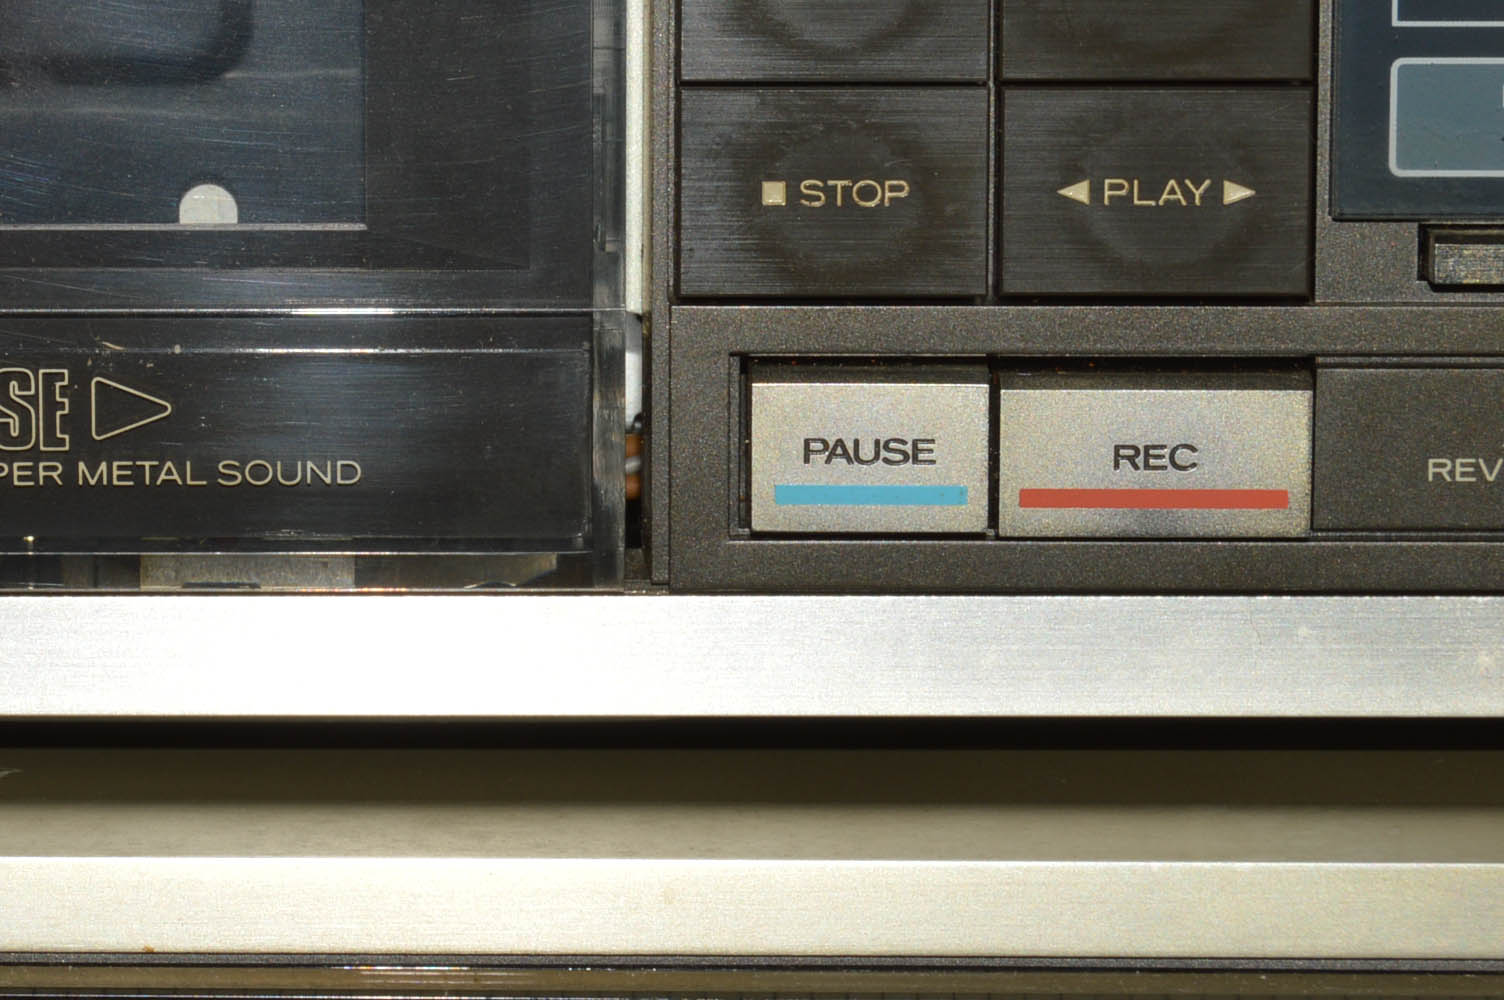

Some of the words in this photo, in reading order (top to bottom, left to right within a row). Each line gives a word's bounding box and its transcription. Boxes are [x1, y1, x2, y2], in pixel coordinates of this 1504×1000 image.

[799, 180, 910, 207] STOP
[1103, 178, 1211, 207] PLAY
[803, 438, 937, 466] PAUSE
[1112, 443, 1199, 471] REC
[78, 460, 207, 487] METAL
[217, 459, 363, 486] SOUND
[1427, 457, 1504, 482] REV
